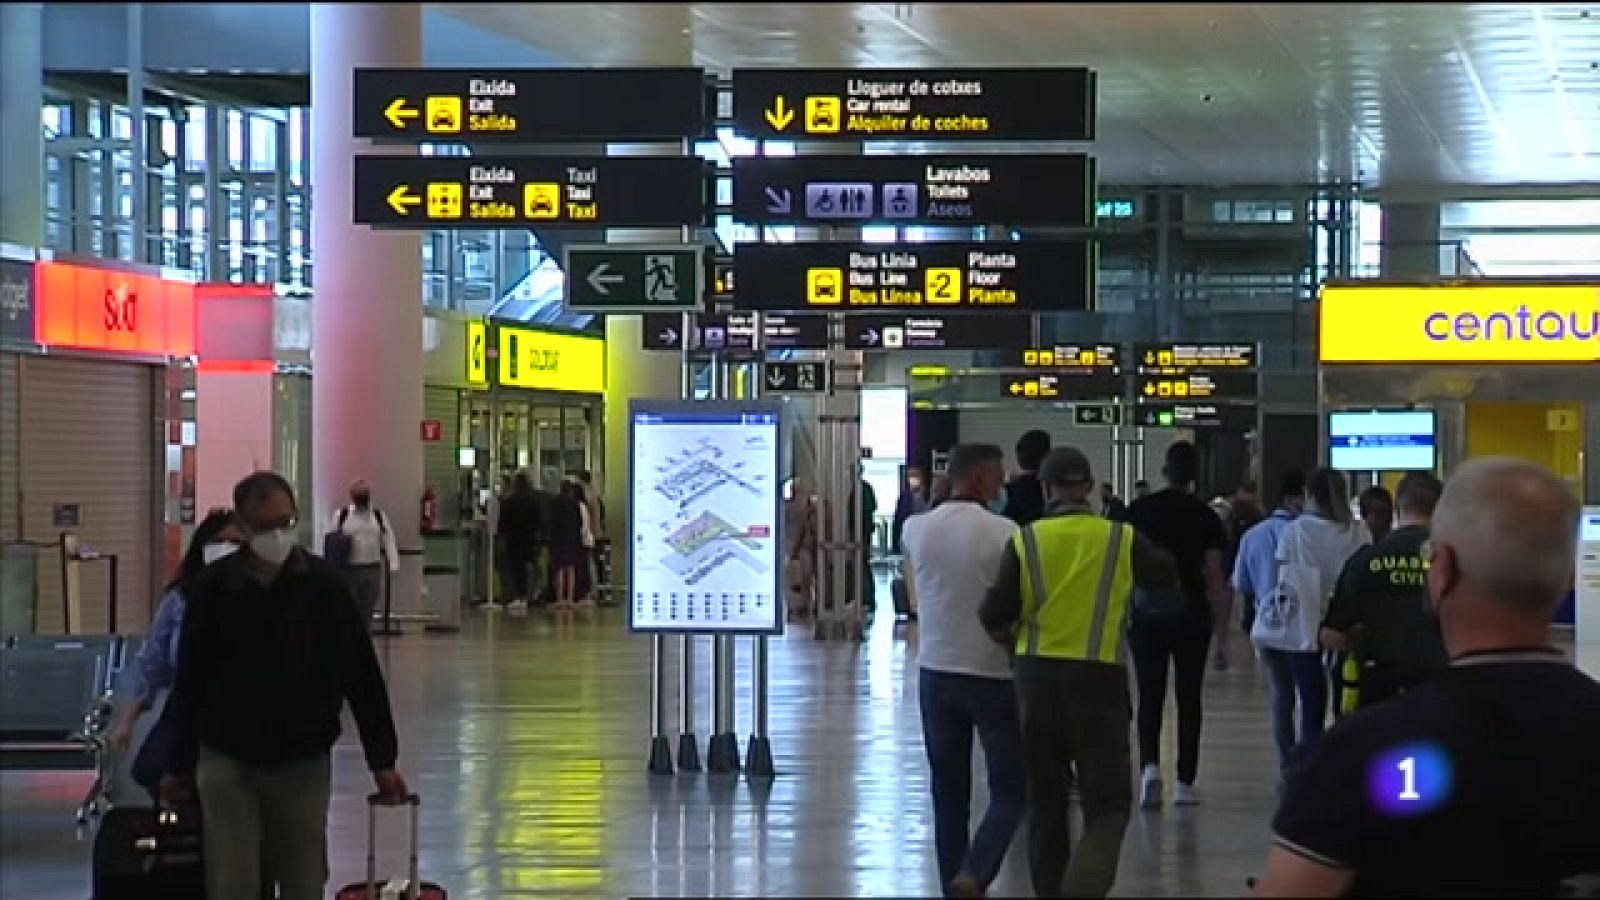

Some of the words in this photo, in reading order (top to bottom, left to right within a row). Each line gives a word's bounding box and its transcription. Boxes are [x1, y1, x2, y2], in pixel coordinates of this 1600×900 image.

[847, 79, 906, 98] Lloguer
[909, 79, 929, 95] de
[932, 79, 982, 96] cotxes
[469, 97, 494, 113] Exit
[847, 97, 870, 112] Car
[872, 97, 911, 113] rental
[469, 114, 516, 131] Salida
[847, 114, 906, 133] Alquiler
[910, 114, 931, 130] de
[934, 114, 988, 130] coches
[566, 167, 597, 183] Taxi
[926, 165, 991, 182] Lavabos
[469, 183, 494, 200] Exit
[469, 202, 516, 218] Salida
[566, 201, 597, 218] Taxi
[849, 252, 878, 268] Bus
[969, 252, 1016, 268] Planta
[849, 269, 874, 286] Bus
[929, 271, 951, 299] -2
[969, 269, 1001, 286] Floor
[849, 287, 878, 304] Bus
[969, 287, 1016, 304] Planta
[1424, 304, 1600, 341] centau
